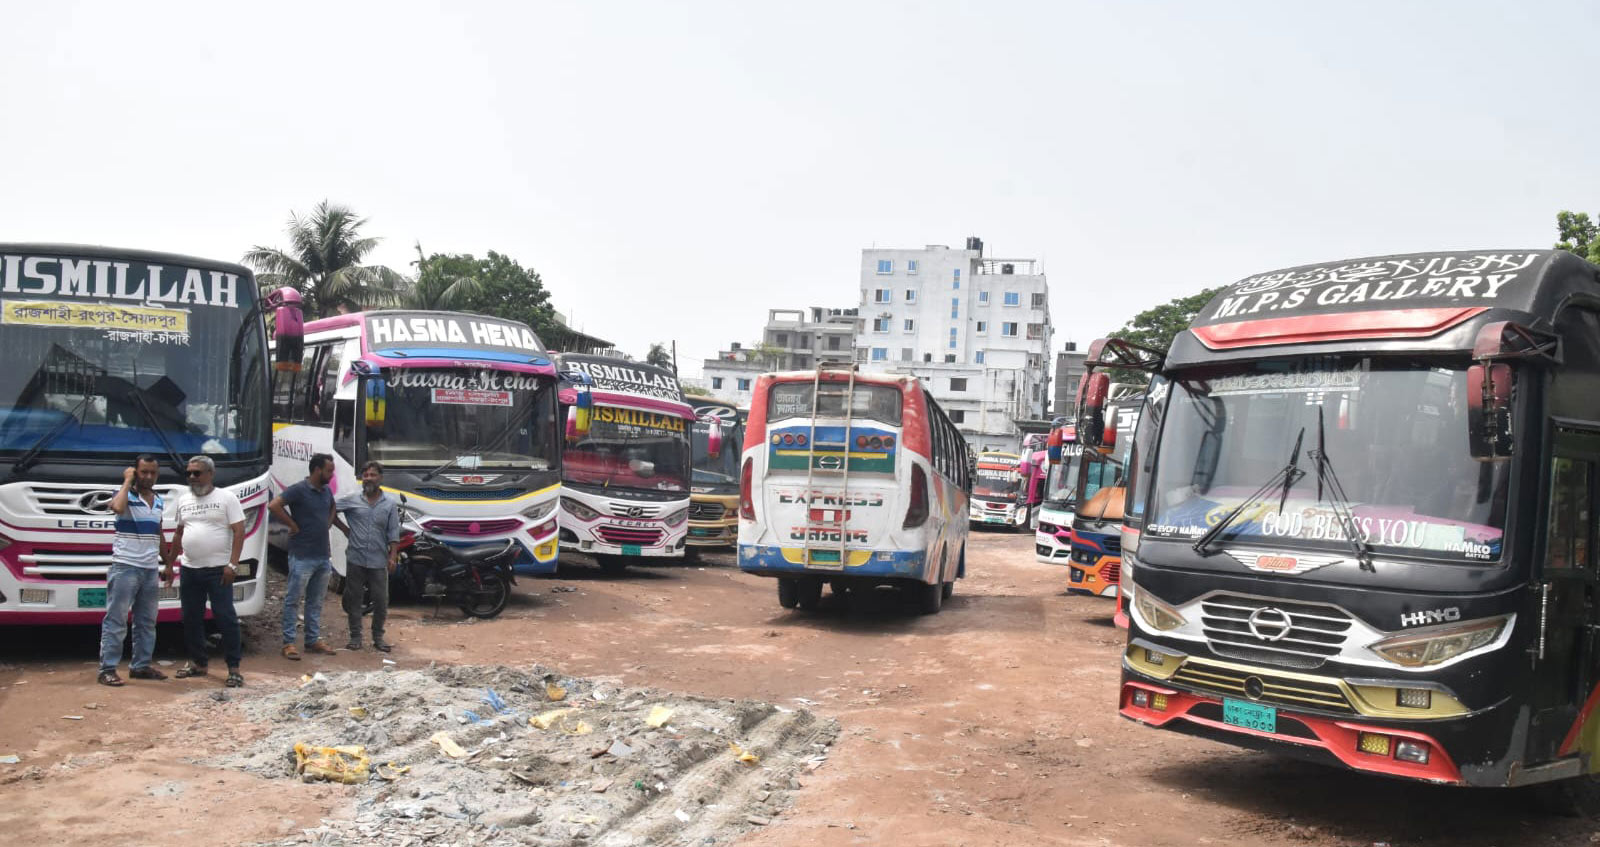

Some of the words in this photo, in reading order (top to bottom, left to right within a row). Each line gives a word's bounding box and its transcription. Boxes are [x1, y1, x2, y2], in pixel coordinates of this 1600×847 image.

[0, 255, 239, 308] ISMILLAH
[1210, 287, 1310, 321] M.P.S
[1317, 274, 1517, 306] GALLERY
[372, 318, 468, 344] HASNA
[469, 321, 540, 351] HENA
[386, 368, 466, 390] Hasna
[566, 361, 680, 392] BISMILLAH
[593, 405, 685, 432] ISMILLAH
[58, 519, 117, 529] LEGA
[1262, 511, 1303, 537] GOD
[1378, 519, 1428, 548] YOU
[1444, 541, 1492, 555] HAMKO
[1400, 606, 1461, 627] HINO
